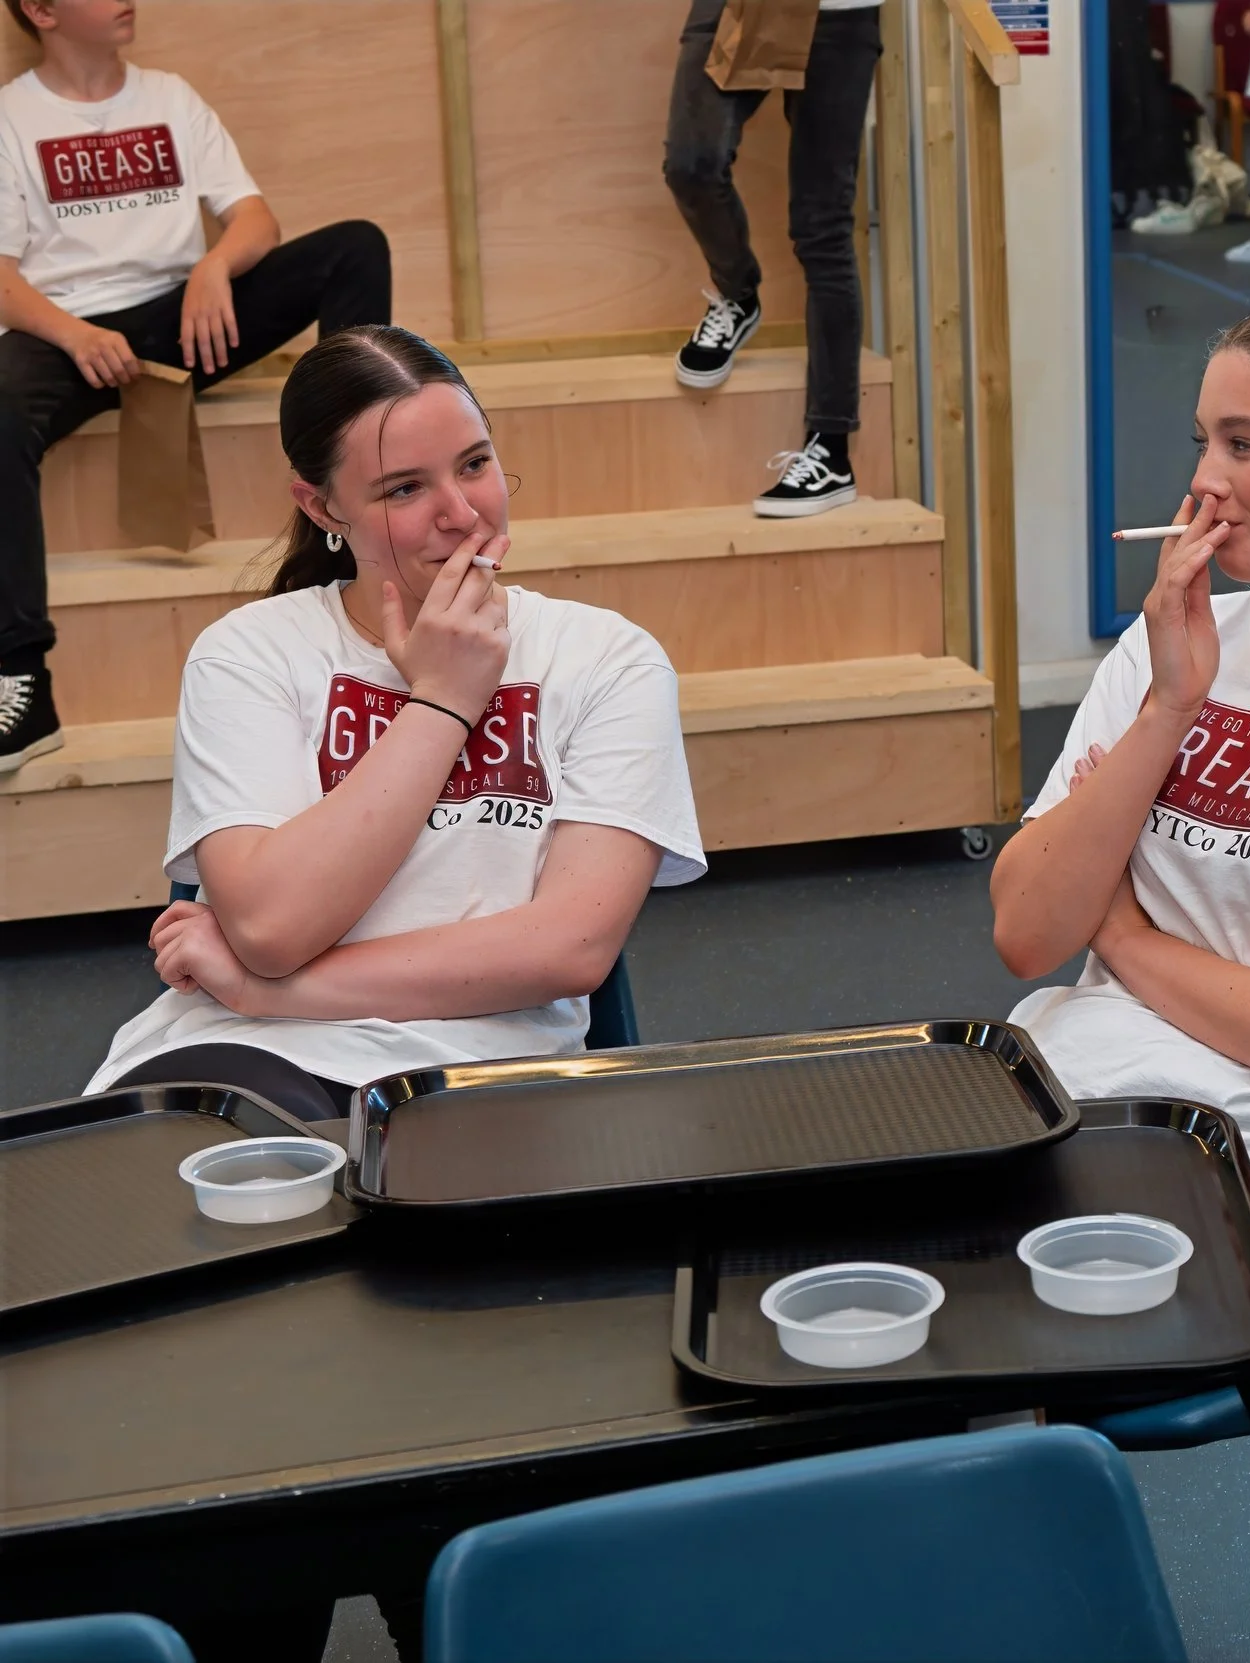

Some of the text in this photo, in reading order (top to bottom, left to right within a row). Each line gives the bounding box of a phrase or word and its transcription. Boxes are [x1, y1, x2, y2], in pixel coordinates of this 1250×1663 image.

[69, 140, 83, 150] WE
[54, 139, 171, 185] GREASE
[56, 188, 180, 219] DOSYTCo 2025
[364, 691, 404, 713] WE G
[1222, 716, 1242, 734] GO
[446, 774, 540, 795] SICAL 59
[477, 799, 544, 831] 2025
[1150, 809, 1216, 852] YTCo
